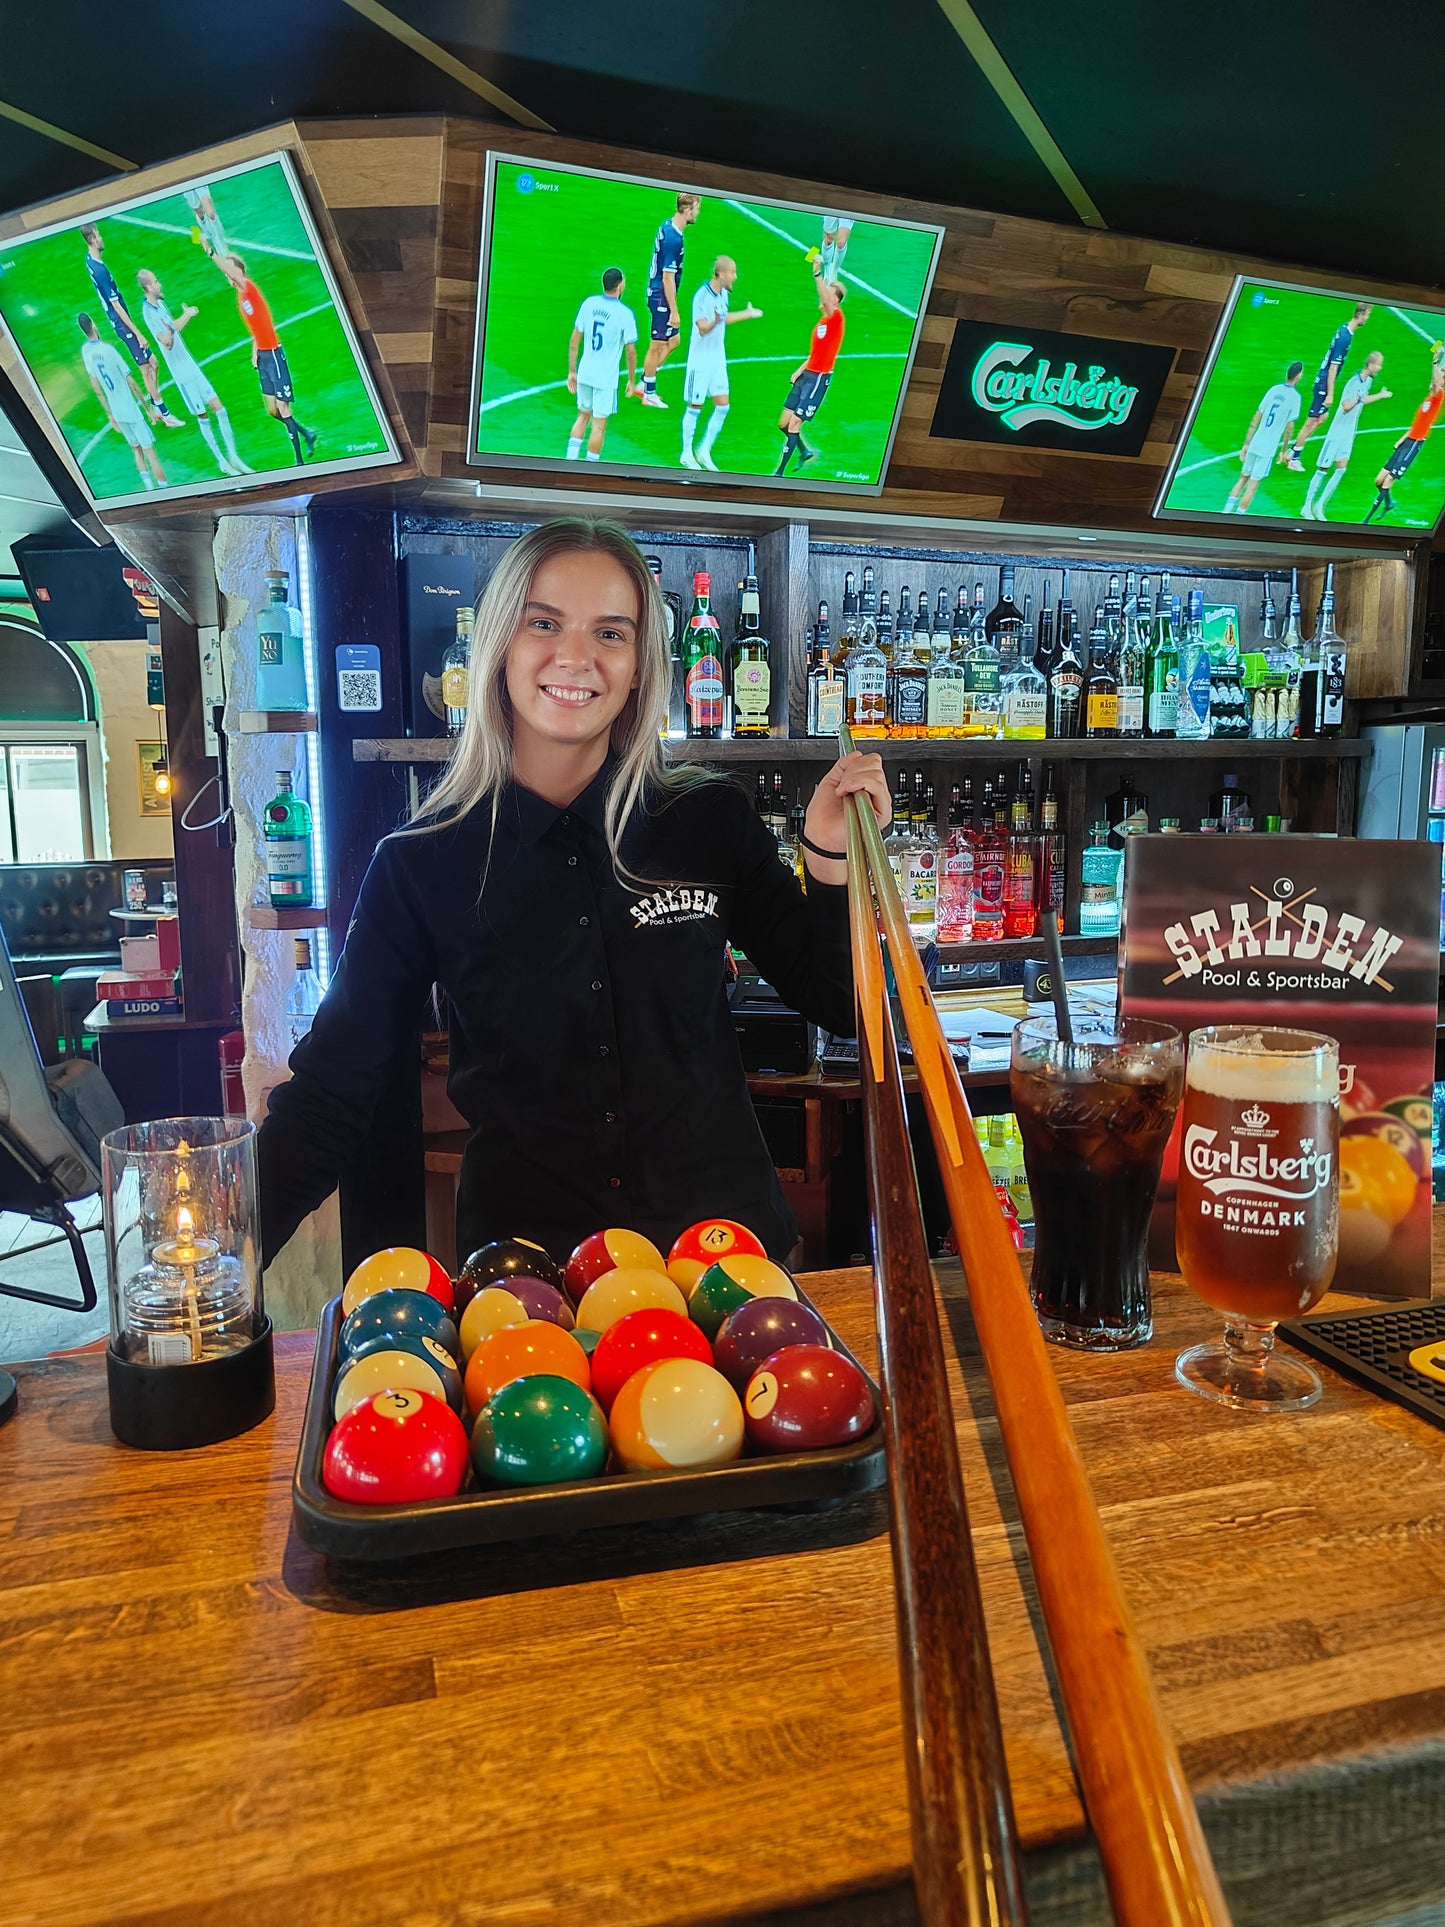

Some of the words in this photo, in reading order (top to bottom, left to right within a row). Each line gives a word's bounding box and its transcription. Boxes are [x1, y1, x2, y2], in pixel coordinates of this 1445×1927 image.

[591, 320, 605, 351] 5
[972, 341, 1139, 427] Carlsberg
[423, 585, 437, 594] Dom
[1011, 854, 1031, 867] CUBA
[629, 889, 718, 924] STALDEN
[649, 918, 665, 926] Pool
[667, 916, 673, 924] &
[674, 912, 706, 923] Sportsbar
[1163, 901, 1403, 985] STALDEN
[1202, 969, 1240, 987] Pool
[1246, 971, 1262, 987] &
[1266, 971, 1350, 991] Sportsbar
[124, 1002, 160, 1013] LUDO
[1185, 1123, 1332, 1190] Carlsberg
[1226, 1196, 1279, 1208] COPENHAGEN
[1201, 1200, 1306, 1226] DENMARK
[705, 1228, 728, 1244] 13
[1223, 1223, 1241, 1233] 1847
[1241, 1224, 1280, 1236] ONWARDS
[386, 1393, 409, 1408] 3
[751, 1382, 768, 1403] 7
